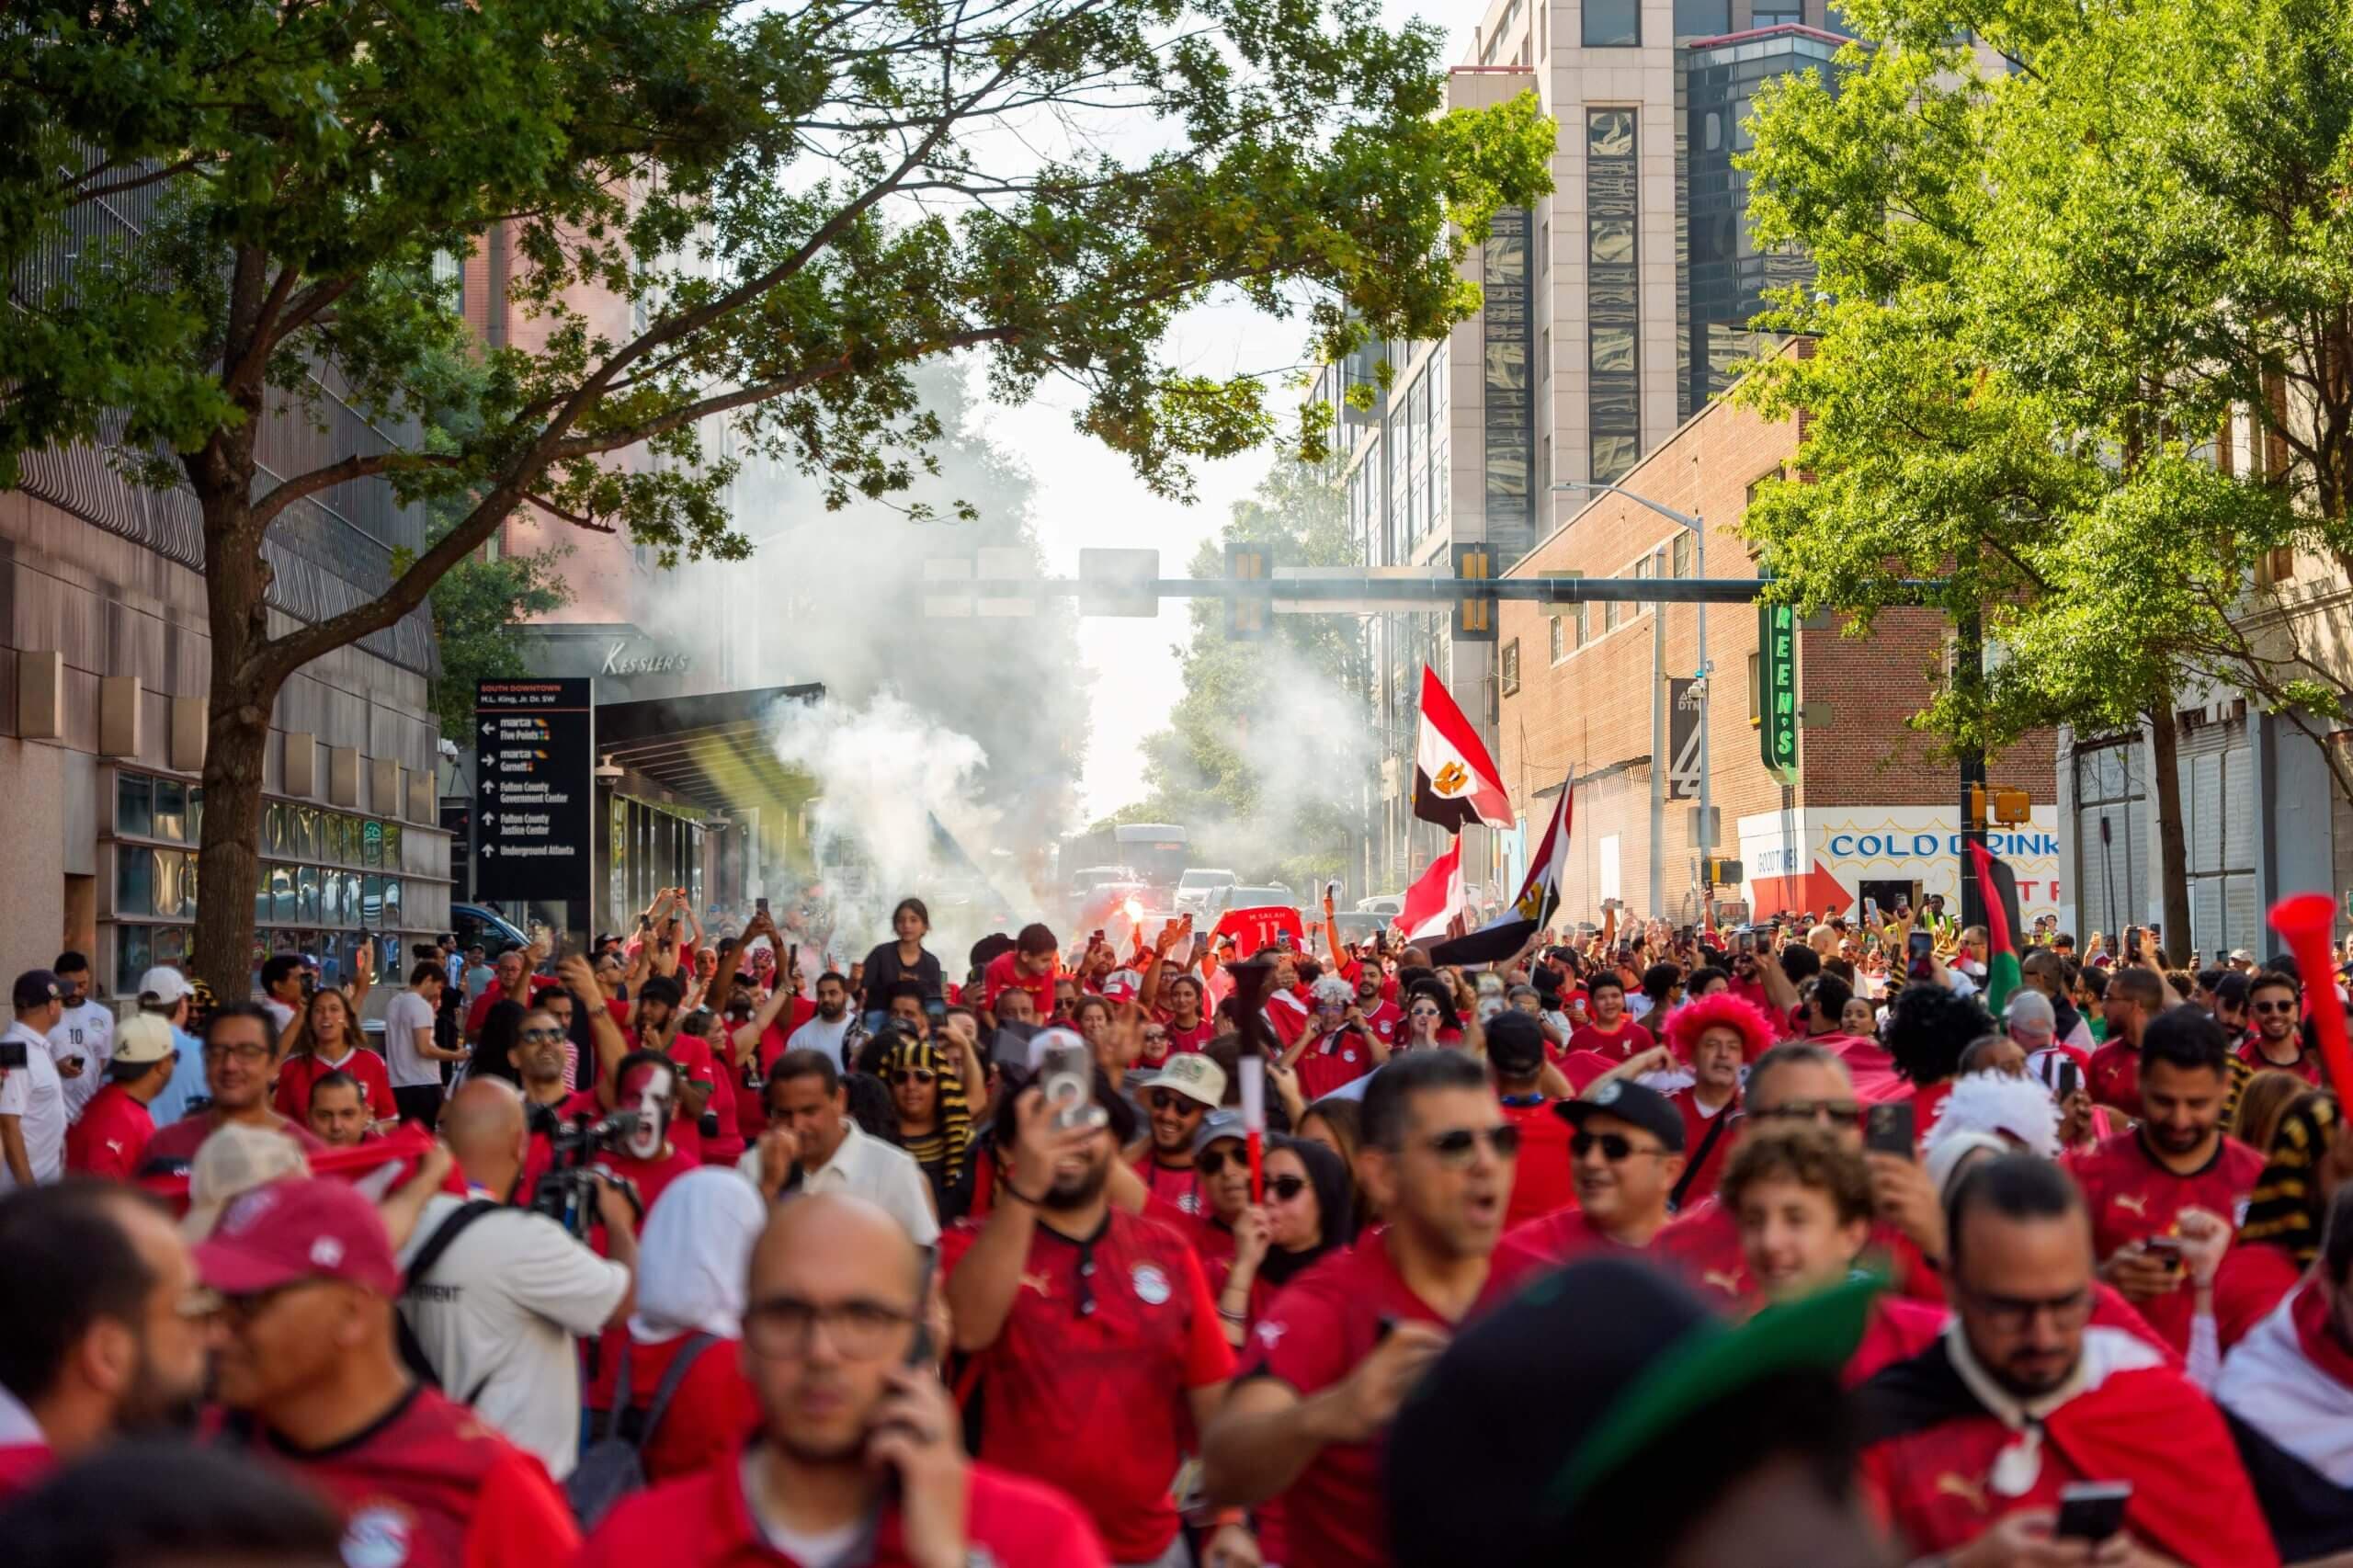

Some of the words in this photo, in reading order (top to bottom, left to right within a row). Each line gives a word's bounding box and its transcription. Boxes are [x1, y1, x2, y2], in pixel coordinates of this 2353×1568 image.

[601, 642, 689, 675] KESSLER'S
[498, 696, 517, 704] King,
[500, 719, 532, 727] marta
[500, 730, 516, 740] Five
[517, 730, 539, 740] Points
[500, 750, 532, 758] marta
[500, 761, 528, 771] Garnett
[500, 782, 523, 791] Fulton
[524, 782, 550, 793] County
[500, 794, 544, 802] Government
[545, 794, 569, 802] Center
[500, 813, 523, 824] Fulton
[524, 813, 550, 824] County
[500, 825, 525, 835] Justice
[526, 825, 550, 835] Center
[1831, 834, 1939, 857] COLD
[500, 846, 548, 857] Underground
[549, 846, 575, 855] Atlanta
[69, 1028, 84, 1045] 10
